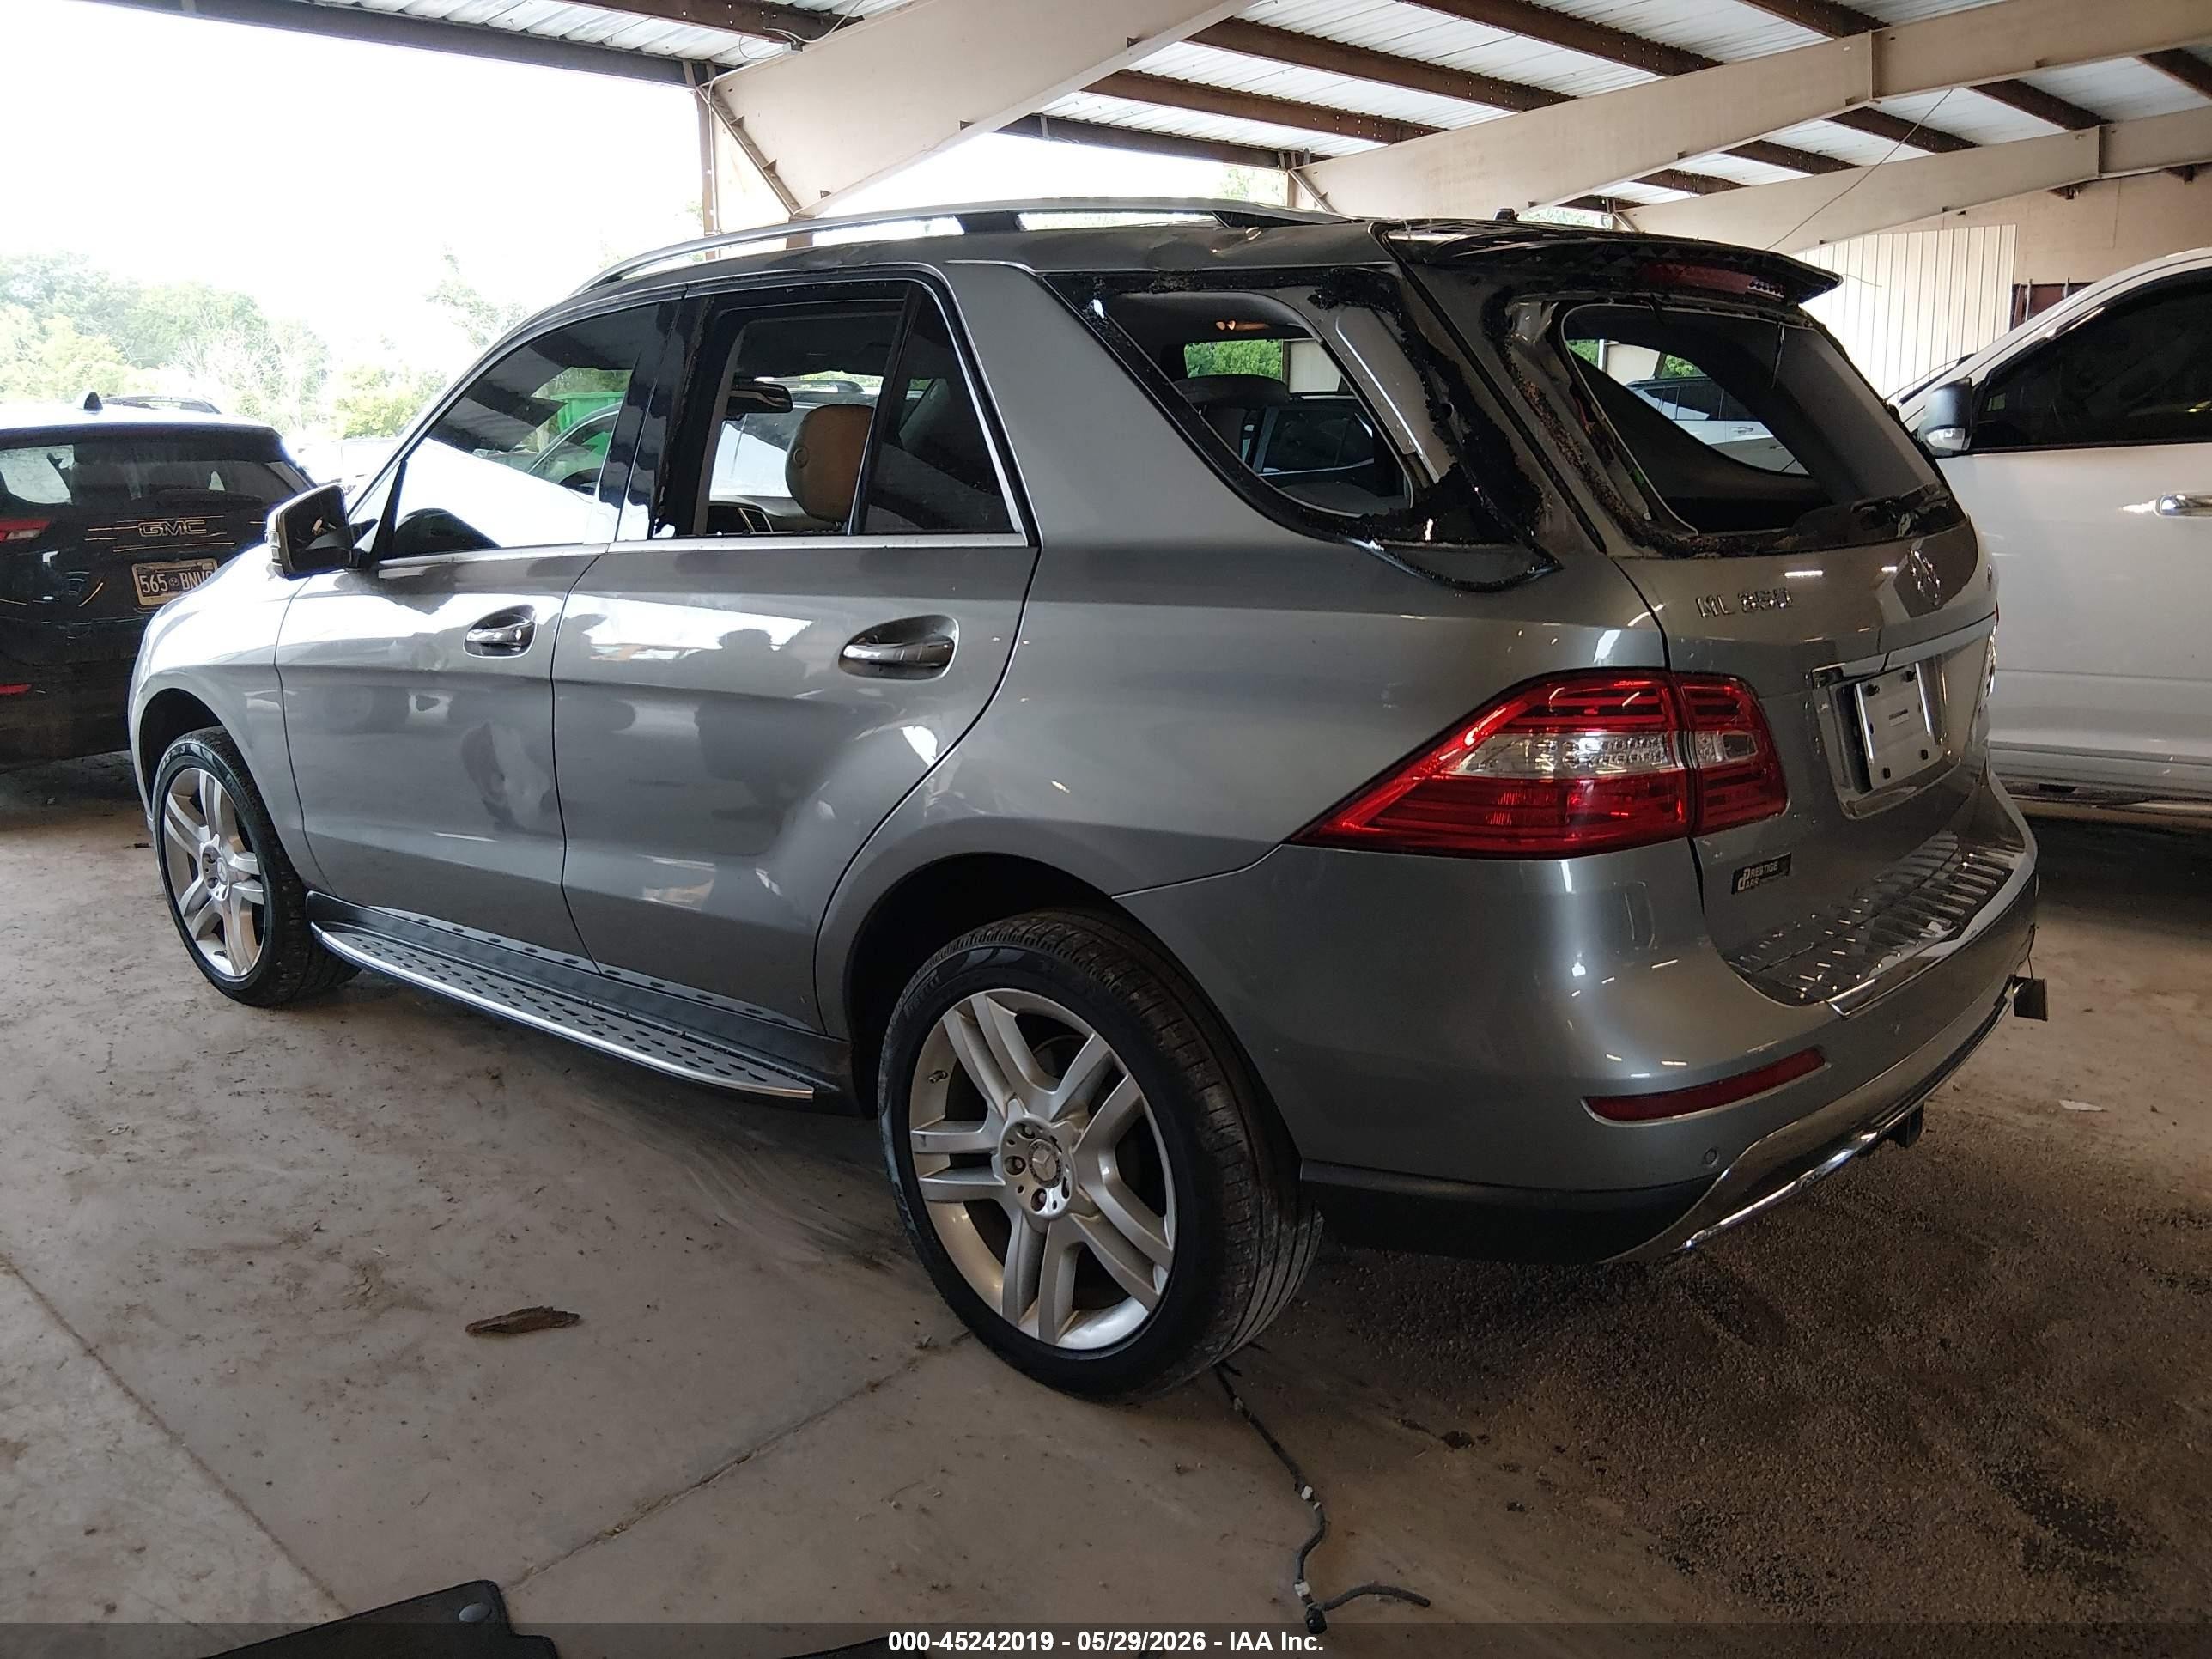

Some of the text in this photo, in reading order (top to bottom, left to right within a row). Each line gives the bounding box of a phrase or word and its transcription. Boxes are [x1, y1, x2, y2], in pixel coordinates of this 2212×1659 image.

[138, 520, 206, 537] GMC
[139, 574, 168, 593] 565
[1696, 588, 1793, 617] ML 350
